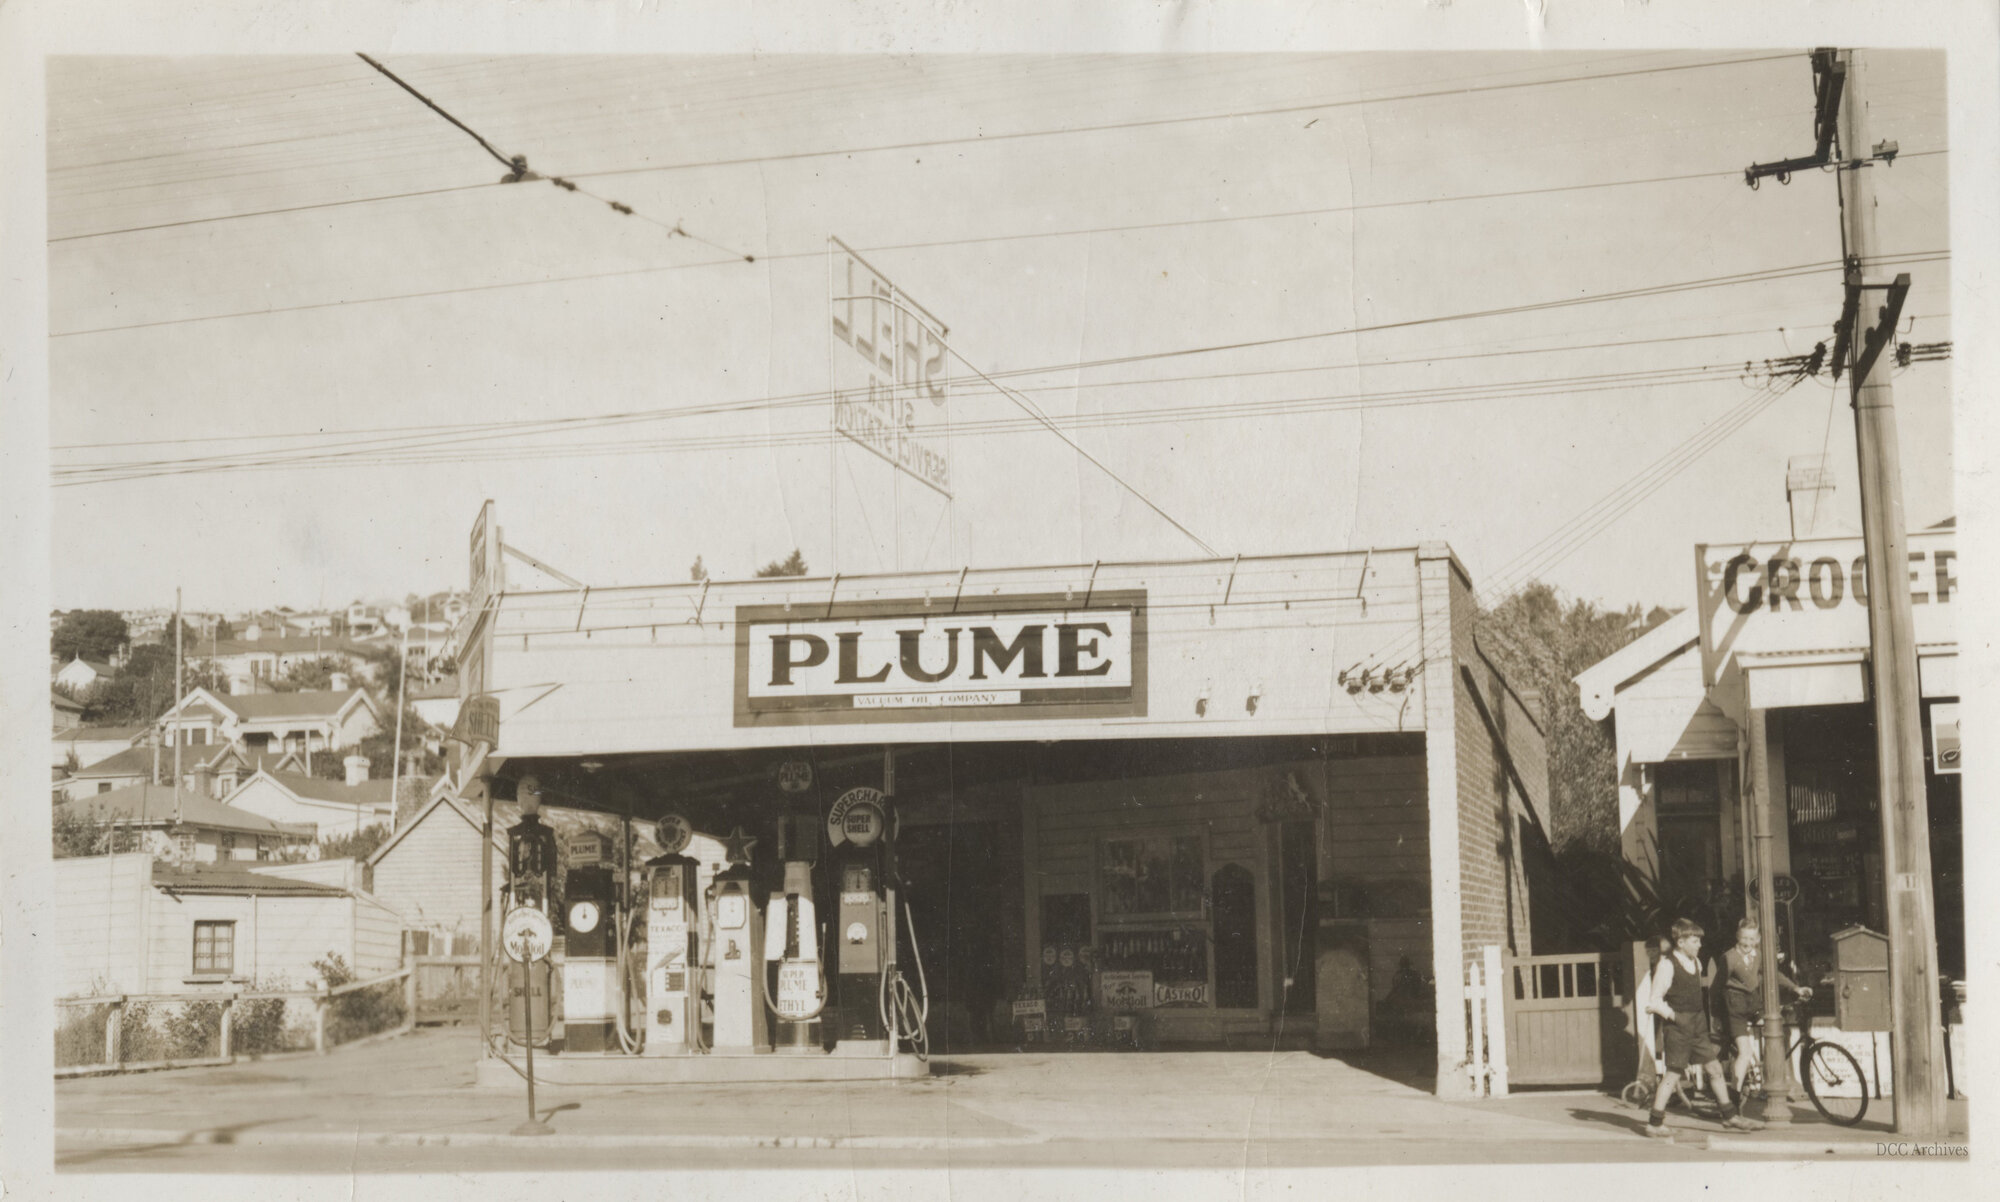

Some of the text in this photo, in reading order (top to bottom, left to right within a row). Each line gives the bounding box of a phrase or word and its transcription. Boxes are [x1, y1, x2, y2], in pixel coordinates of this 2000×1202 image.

[768, 622, 1113, 686] PLUME
[858, 693, 998, 705] VACUUM OIL COMPANY
[468, 711, 496, 739] SHELL
[847, 814, 871, 824] SUPER
[847, 824, 871, 833] SHELL
[570, 844, 598, 855] PLUME
[510, 941, 545, 955] Moloil
[514, 987, 542, 997] SHLL
[1156, 986, 1209, 1005] CASTROL
[779, 999, 807, 1011] ETHYL
